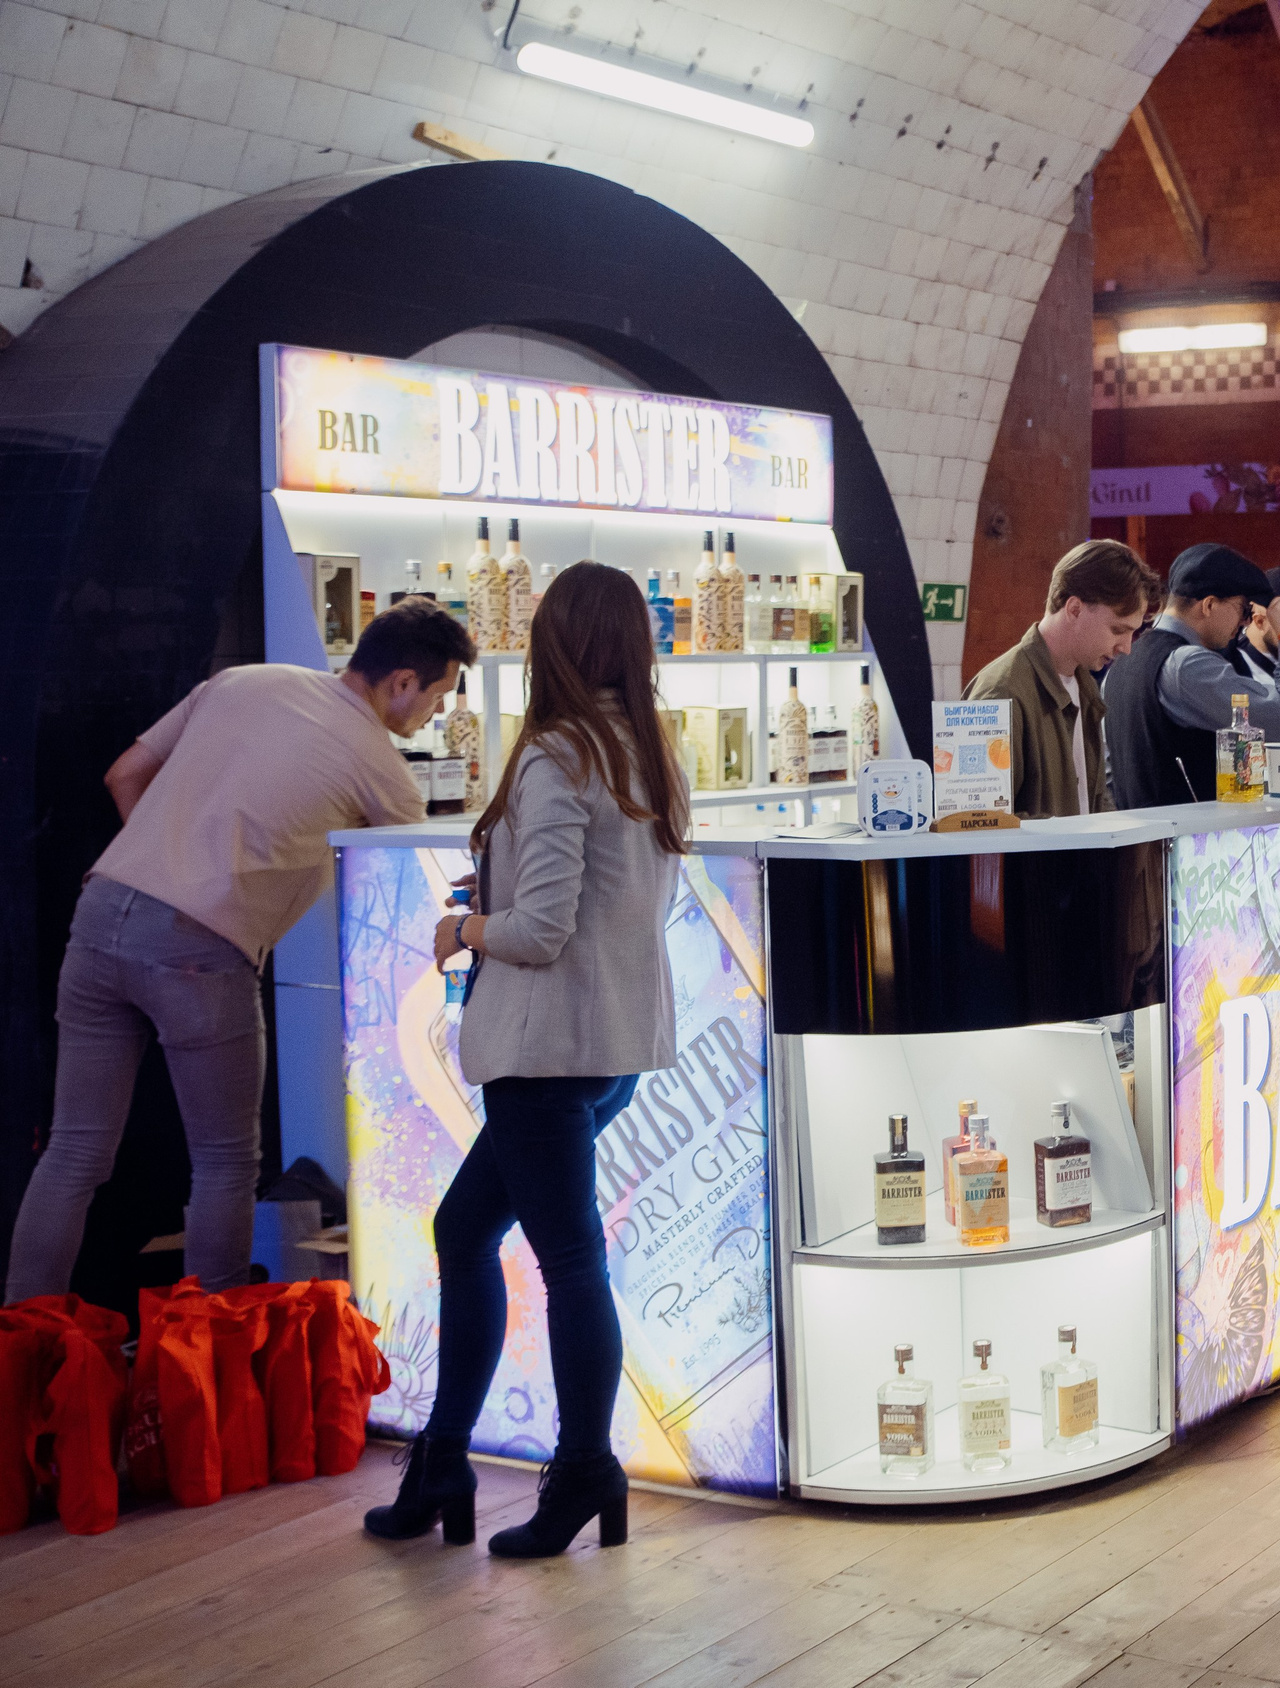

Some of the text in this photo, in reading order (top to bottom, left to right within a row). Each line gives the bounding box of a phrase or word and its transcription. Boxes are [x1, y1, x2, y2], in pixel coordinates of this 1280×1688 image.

[317, 409, 380, 455] BAR
[436, 376, 732, 513] BARRISTER
[771, 455, 808, 490] BAR
[944, 704, 999, 716] ВЫИГРАЙ НАБОР
[946, 716, 998, 727] ДЛЯ КОКТЕЙЛЯ!
[960, 818, 999, 829] ЦАРСКАЯ
[594, 1015, 768, 1217] RRISTER
[608, 1106, 768, 1258] DRY GIN
[881, 1186, 923, 1200] BARRISTER
[965, 1187, 1006, 1201] BARRISTER
[642, 1153, 764, 1261] MASTERLY CRAFTED
[626, 1256, 668, 1295] ORIGINAL
[668, 1233, 697, 1261] BLEND
[697, 1218, 712, 1233] OF
[638, 1271, 669, 1300] SPICES
[668, 1257, 687, 1275] AND
[687, 1240, 707, 1263] THE
[707, 1212, 738, 1243] FINEST
[883, 1413, 915, 1424] BARRISTER
[972, 1409, 1004, 1420] BARRISTER
[975, 1428, 1002, 1437] VODKA
